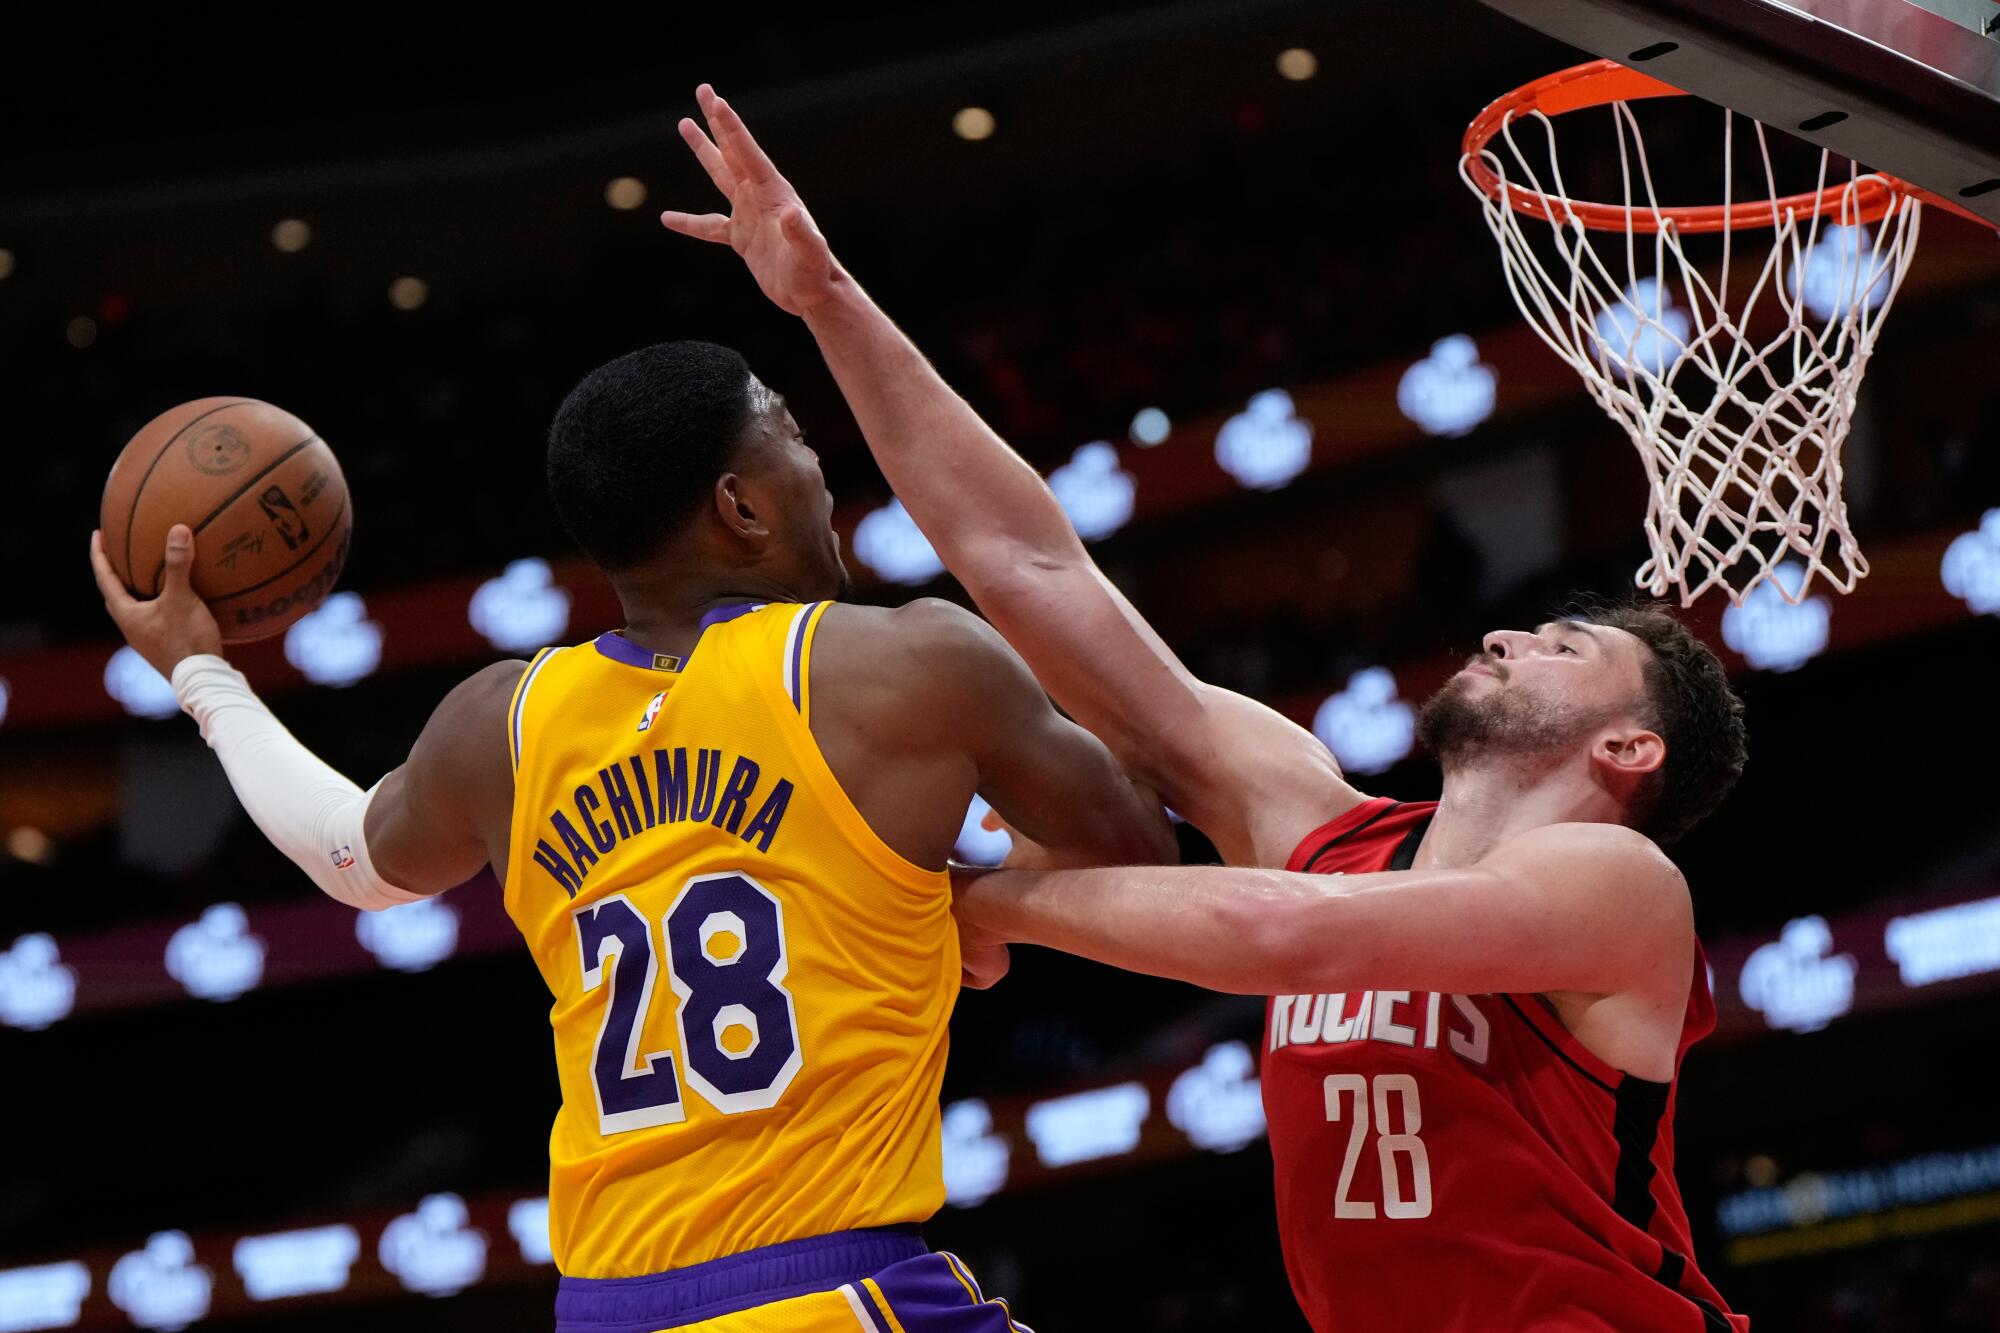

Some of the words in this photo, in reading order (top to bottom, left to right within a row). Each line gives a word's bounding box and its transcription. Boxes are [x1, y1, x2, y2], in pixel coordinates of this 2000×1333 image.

[533, 747, 795, 899] HACHIMURA
[571, 869, 804, 1136] 28
[1323, 1073, 1433, 1220] 28
